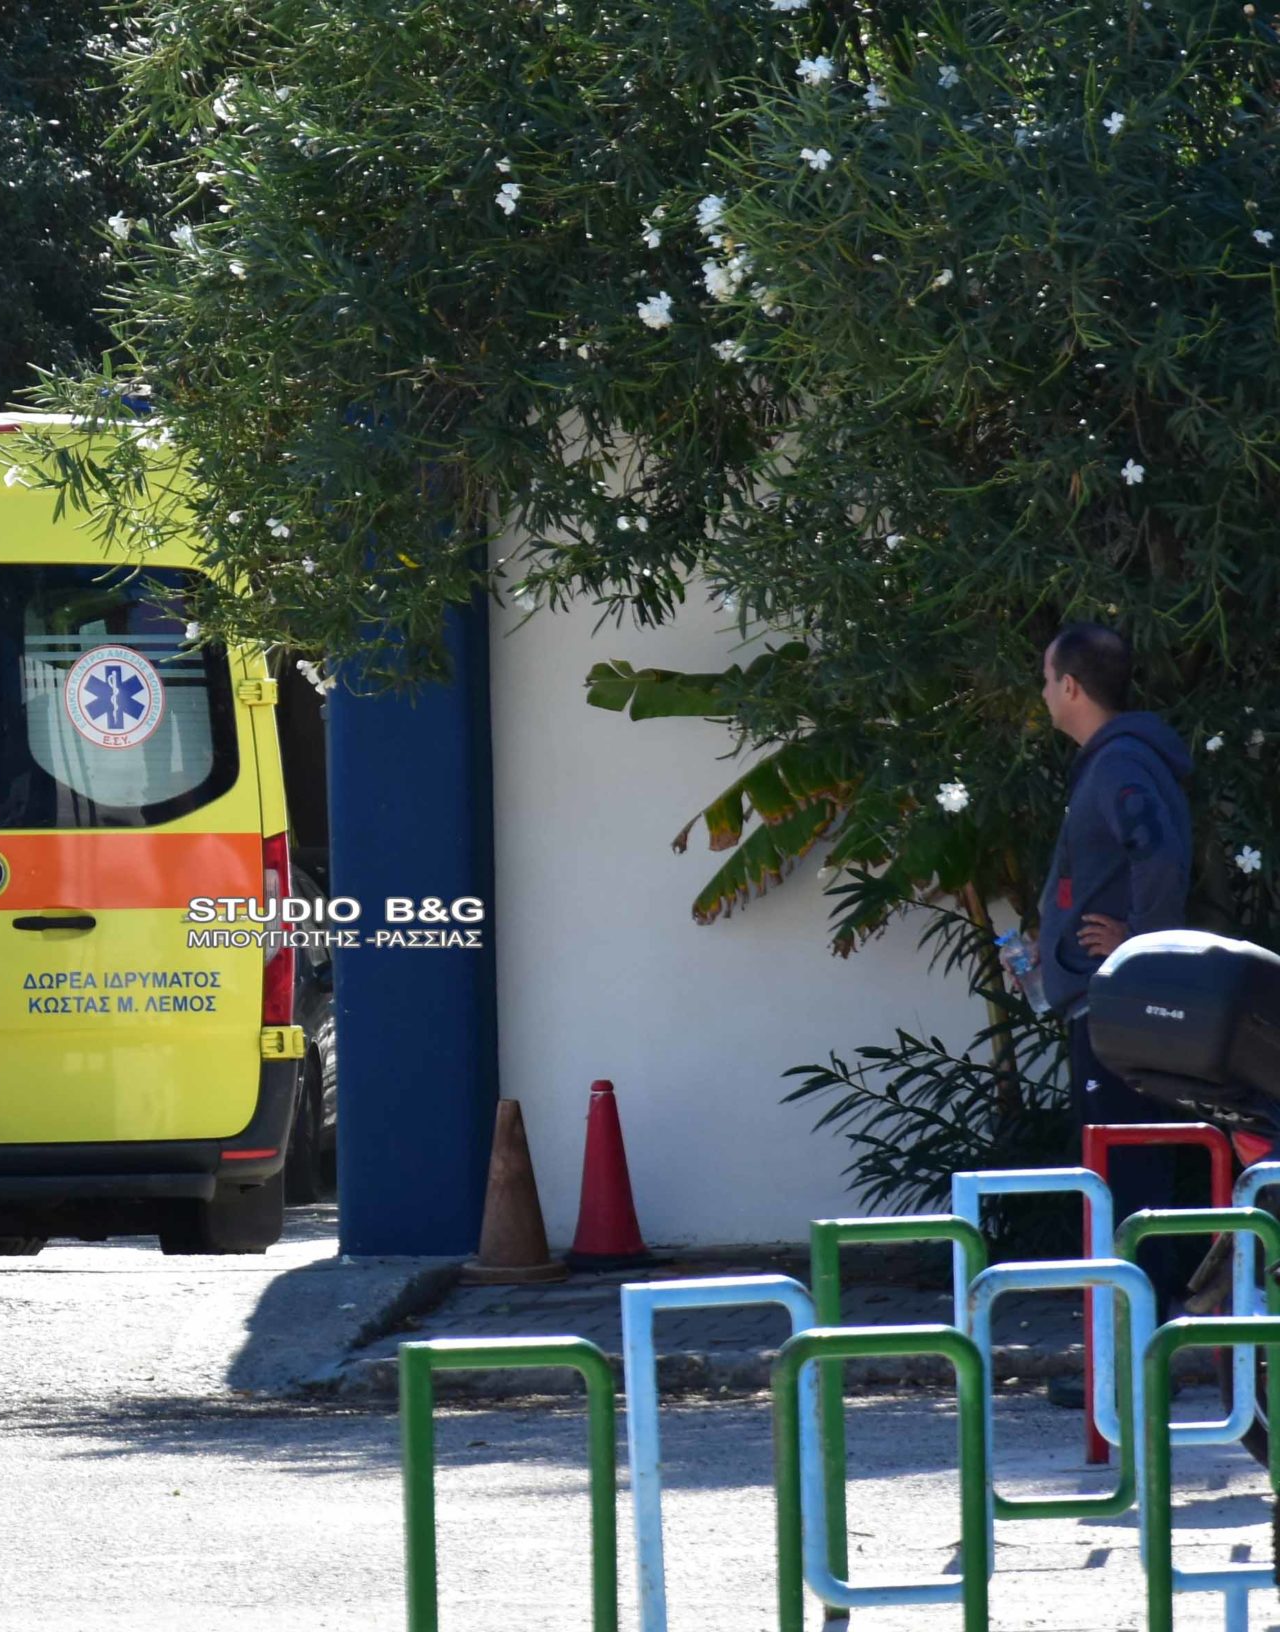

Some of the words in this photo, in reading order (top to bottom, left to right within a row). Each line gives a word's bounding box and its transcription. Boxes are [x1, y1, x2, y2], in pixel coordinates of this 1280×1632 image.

[23, 972, 97, 989] ΔΩΡΕΑ
[104, 971, 221, 989] ΙΔΡΥΜΑΤΟΣ
[28, 996, 111, 1013] ΚΩΣΤΑΣ
[117, 996, 139, 1013] Μ.
[145, 995, 217, 1012] ΛΕΜΟΣ
